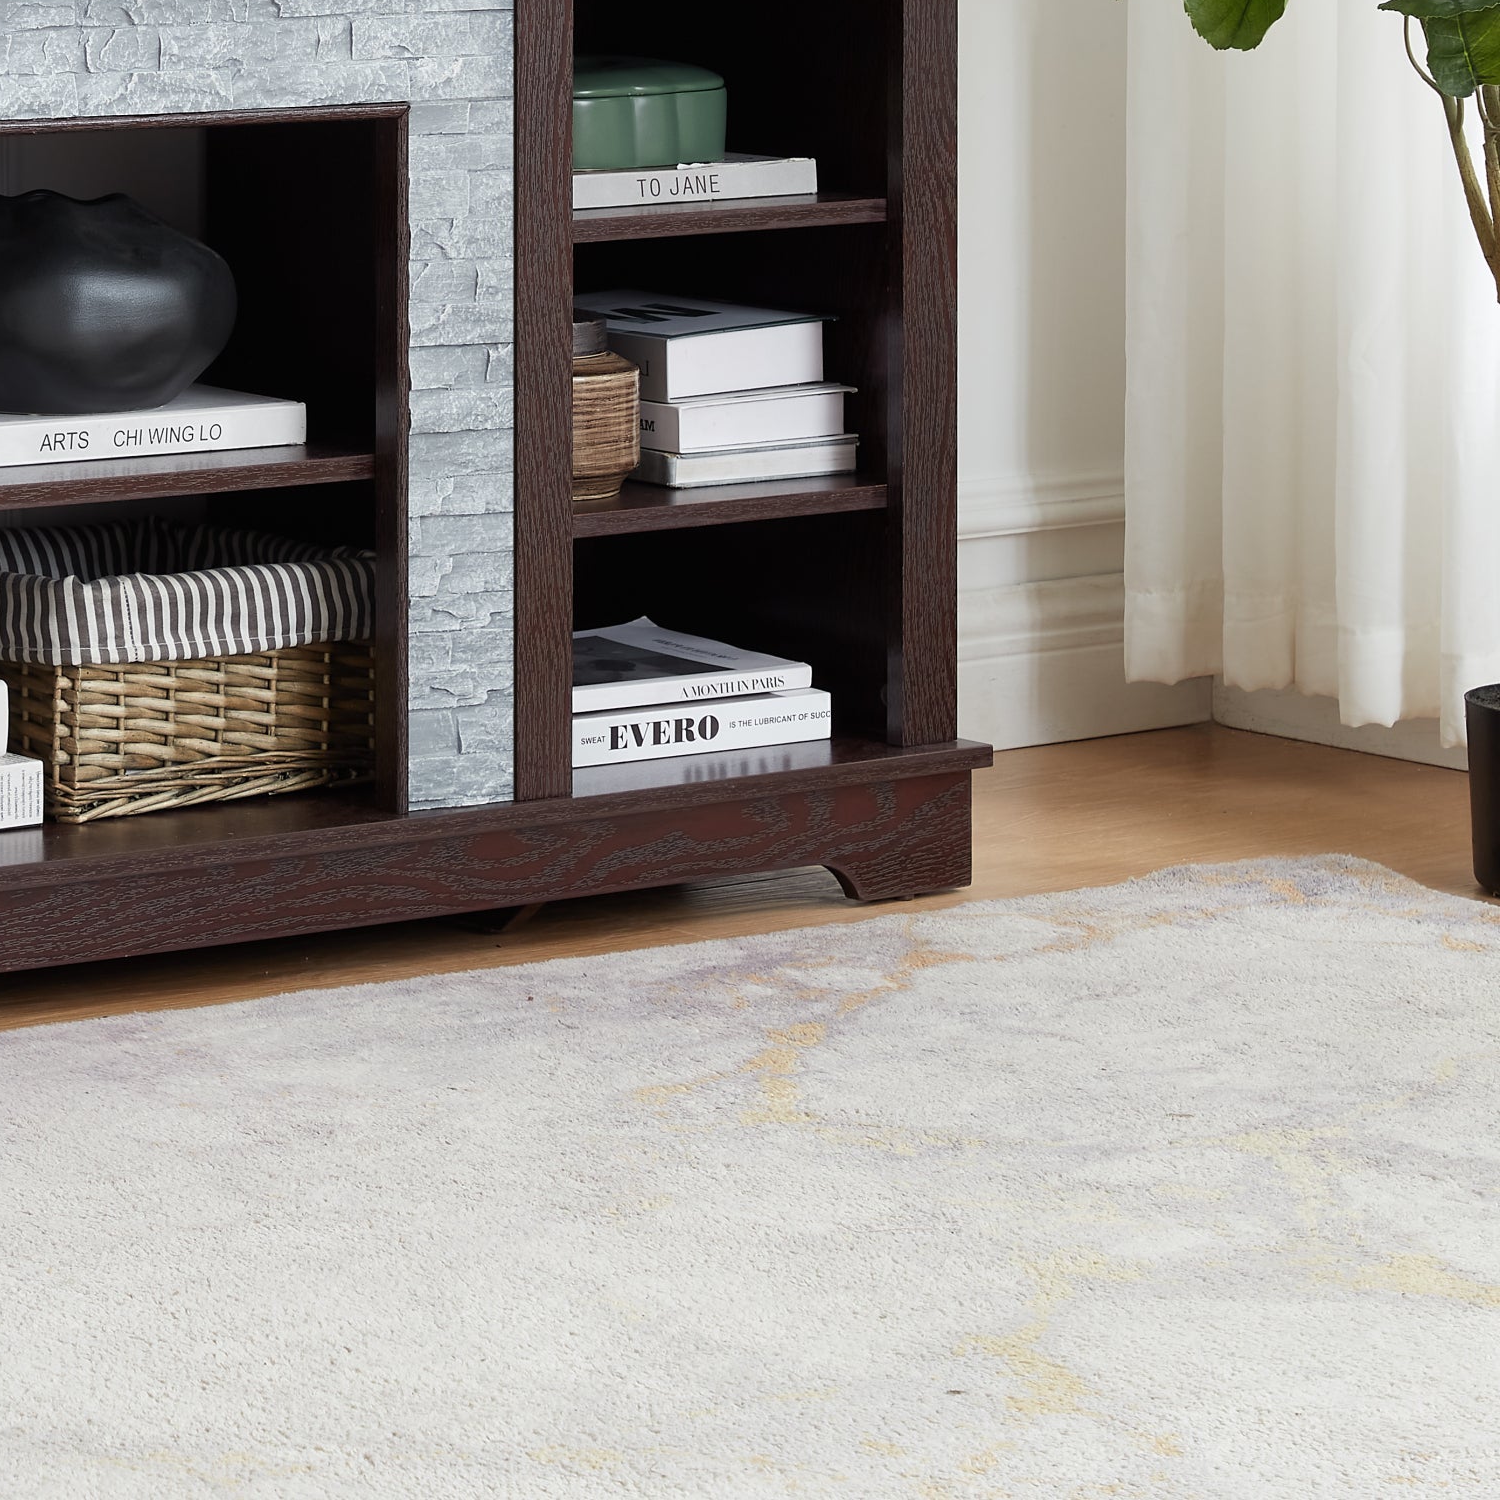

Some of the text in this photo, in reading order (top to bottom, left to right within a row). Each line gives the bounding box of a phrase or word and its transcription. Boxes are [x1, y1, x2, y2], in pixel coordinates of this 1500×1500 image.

[636, 174, 720, 198] TO JANE
[39, 423, 222, 452] ARTS CHI WING LO
[680, 675, 786, 698] A MONTH IN PARIS
[580, 735, 607, 746] SWEAT
[608, 714, 720, 751] EVERO
[729, 721, 737, 729] IS
[738, 719, 753, 728] THE
[754, 714, 797, 726] LUBRICANT
[798, 712, 809, 721] OF
